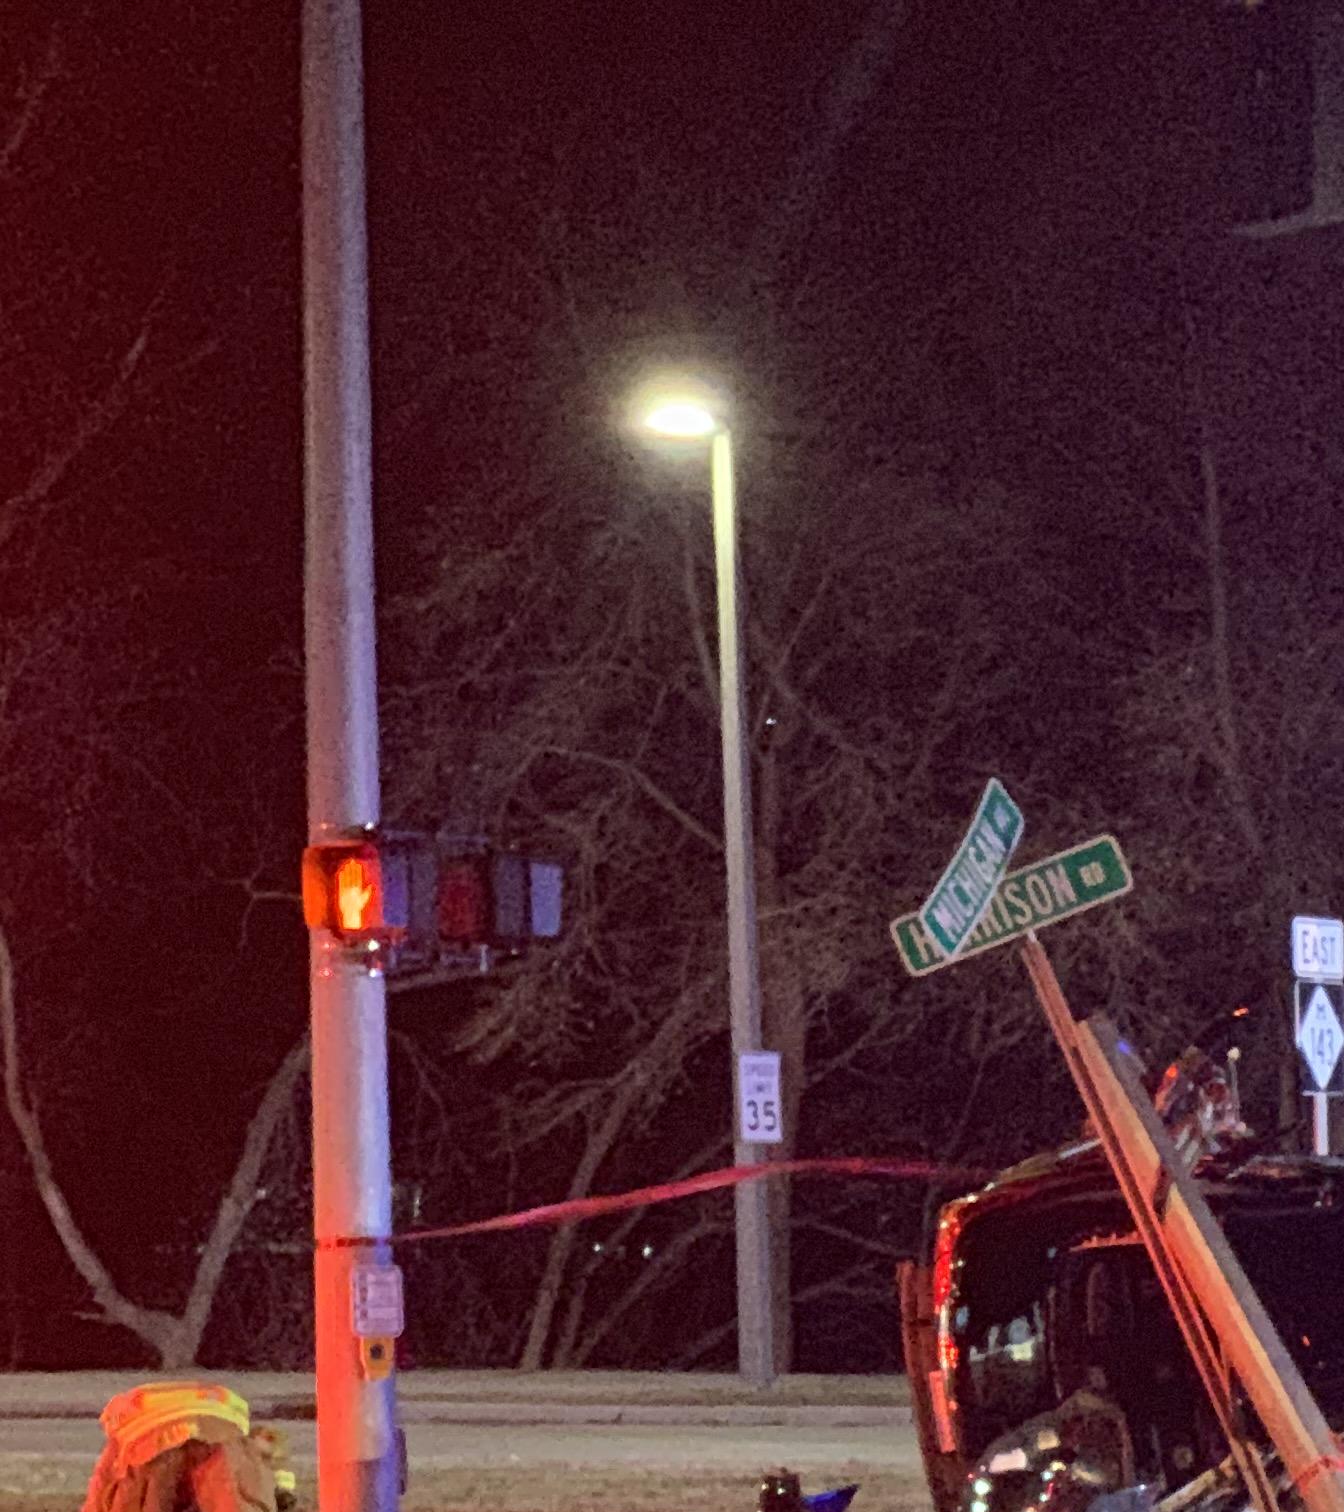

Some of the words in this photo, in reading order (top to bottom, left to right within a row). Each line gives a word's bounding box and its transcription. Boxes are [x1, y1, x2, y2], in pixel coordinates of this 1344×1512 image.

[908, 862, 1077, 963] HRISON
[1302, 930, 1336, 965] EAST
[1310, 1027, 1334, 1066] 143
[746, 1100, 777, 1132] 35
